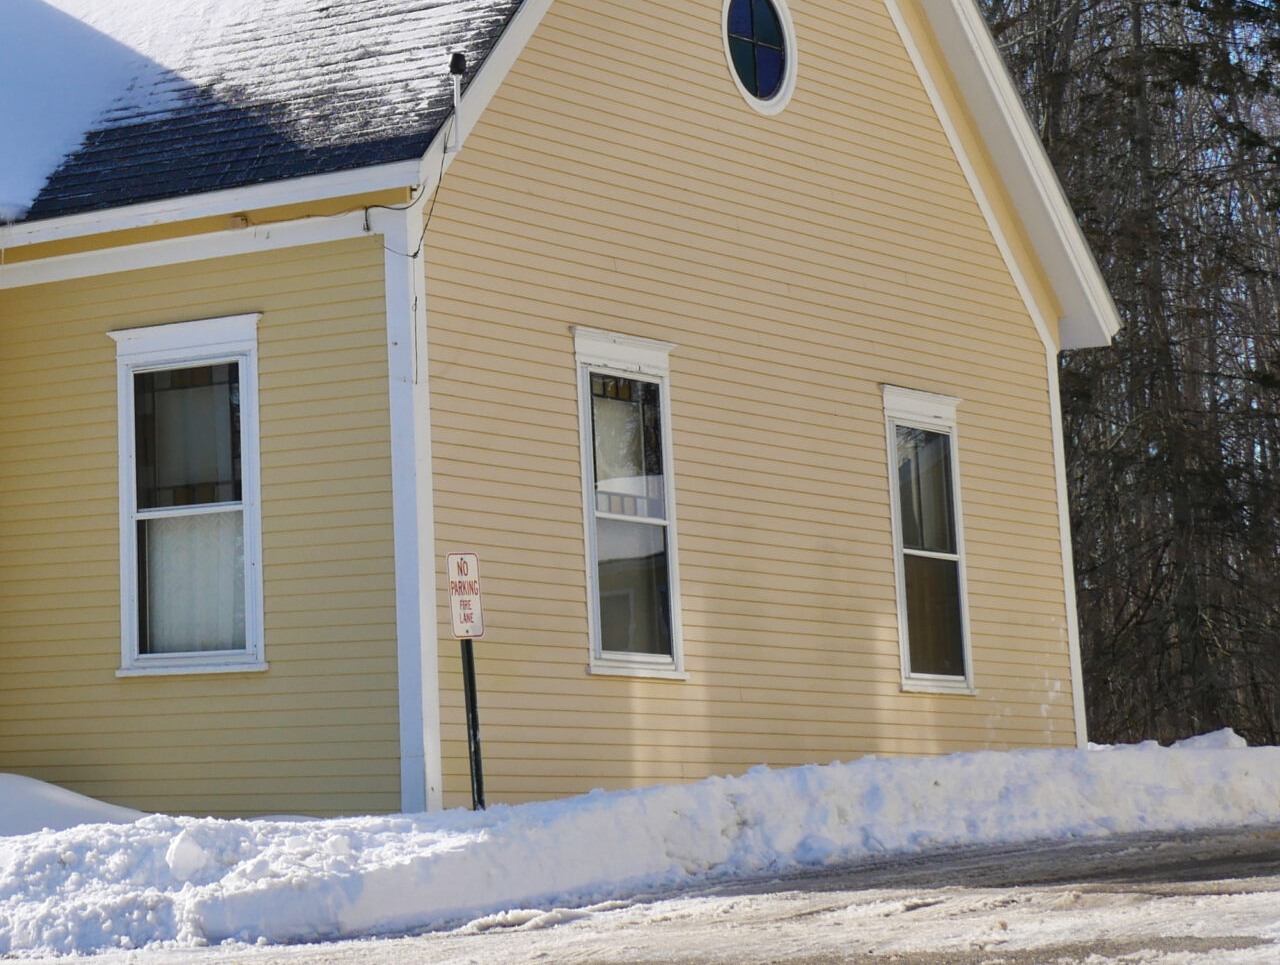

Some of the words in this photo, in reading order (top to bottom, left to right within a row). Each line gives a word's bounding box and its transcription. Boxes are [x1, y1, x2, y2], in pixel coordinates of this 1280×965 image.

[457, 561, 469, 576] NO
[450, 580, 479, 596] PARKING
[459, 599, 472, 610] FIRE
[459, 613, 474, 624] LANE
